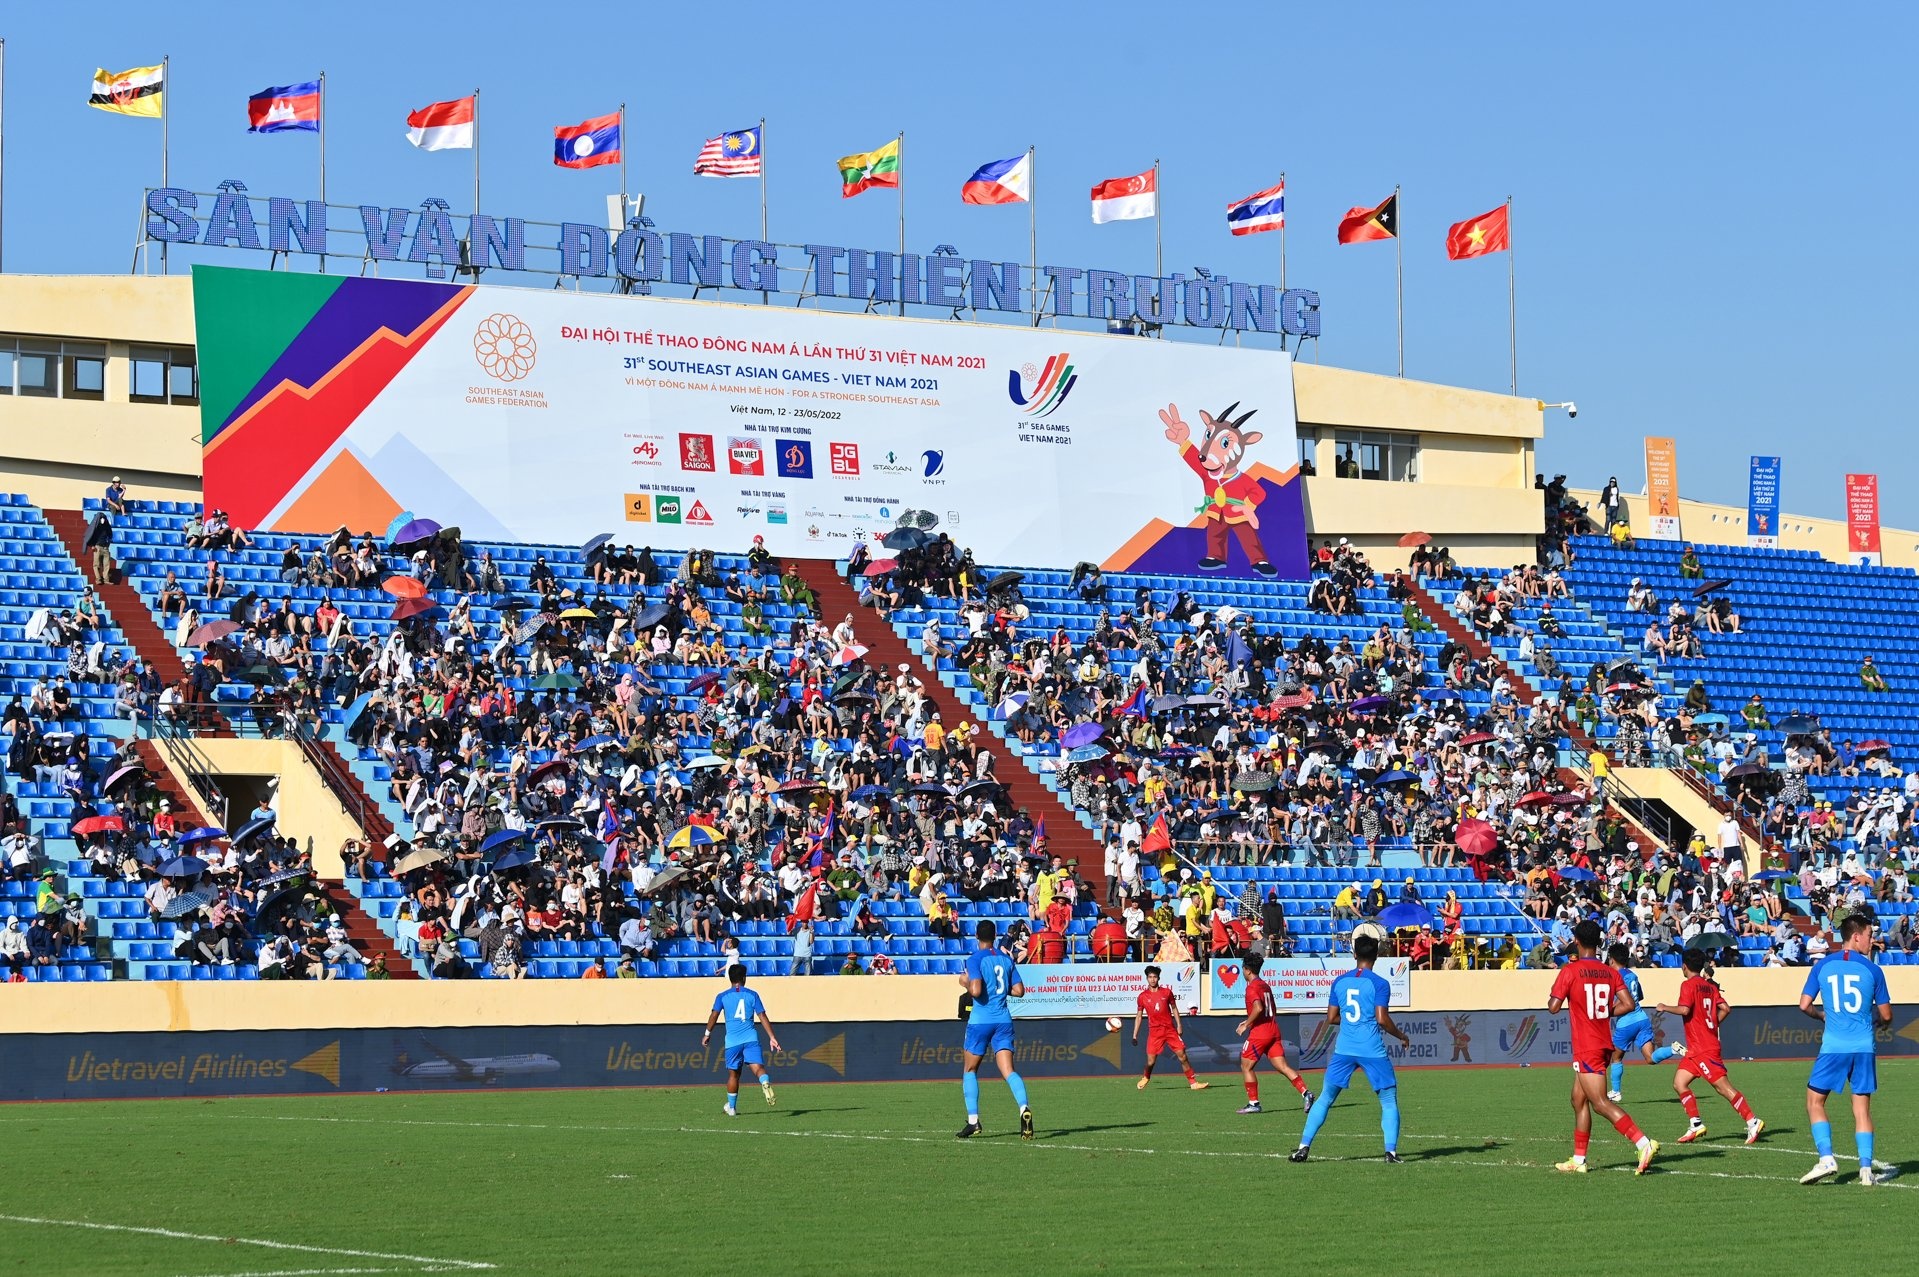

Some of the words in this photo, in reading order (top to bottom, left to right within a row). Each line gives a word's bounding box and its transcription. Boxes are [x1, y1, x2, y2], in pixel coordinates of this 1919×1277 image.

[146, 179, 327, 254] SÂN
[359, 197, 525, 279] VẬN
[557, 216, 779, 295] ĐỘNG
[804, 244, 1020, 312] THIÊN
[1044, 265, 1321, 337] TRƯỜNG
[561, 326, 588, 342] ĐẠI
[592, 327, 620, 344] HỘI
[624, 329, 653, 345] THỂ
[657, 334, 699, 348] THAO
[702, 336, 747, 352] ĐÔNG
[751, 341, 785, 355] NAM
[789, 342, 800, 356] Á
[804, 343, 832, 358] LẦN
[836, 346, 866, 361] THỨ
[869, 350, 882, 362] 31
[886, 350, 917, 366] VIỆT
[921, 355, 953, 367] NAM
[957, 356, 986, 369] 2021
[624, 356, 645, 369] 31st
[649, 359, 731, 376] SOUTHEAST
[735, 365, 778, 379] ASIAN
[782, 369, 830, 383] GAMES
[842, 373, 871, 386] VIET
[875, 376, 907, 388] NAM
[910, 378, 938, 390] 2021
[465, 396, 496, 405] GAMES
[497, 398, 548, 408] FEDERATION
[468, 387, 518, 397] SOUTHEAST
[520, 390, 544, 399] ASIAN
[625, 376, 634, 386] VÌ
[636, 378, 656, 389] MỘT
[658, 379, 686, 389] ĐÔNG
[688, 382, 708, 391] NAM
[710, 381, 717, 392] Á
[719, 385, 746, 395] MẠNH
[749, 385, 762, 395] MẼ
[764, 386, 784, 396] HƠN
[792, 389, 809, 398] FOR
[811, 391, 818, 399] A
[820, 392, 866, 402] STRONGER
[868, 394, 918, 405] SOUTHEAST
[920, 398, 940, 407] ASIA
[730, 404, 748, 414] Việt
[750, 406, 775, 416] Nam,
[777, 408, 786, 416] 12
[793, 409, 842, 420] 23/05/2022
[1018, 434, 1034, 442] VIET
[1036, 435, 1054, 443] NAM
[1055, 436, 1072, 445] 2021
[1030, 423, 1045, 431] SEA
[1046, 424, 1071, 432] GAMES
[684, 461, 711, 469] SAIGON
[734, 450, 744, 458] BIA
[872, 464, 912, 472] STAVIAN
[994, 964, 1005, 995] 3
[1046, 975, 1059, 984] HỘI
[1296, 969, 1309, 977] HAI
[1263, 991, 1274, 1017] 11
[1345, 988, 1361, 1023] 5
[1583, 983, 1610, 1020] 18
[1827, 974, 1863, 1014] 15
[734, 998, 746, 1023] 4
[1154, 1002, 1160, 1012] 4
[1703, 997, 1714, 1029] 3
[1549, 1017, 1568, 1032] 31st
[1754, 1020, 1823, 1045] Vietrave
[606, 1041, 709, 1071] Vietravel
[1409, 1043, 1438, 1058] 2021
[67, 1050, 186, 1082] Vietravel
[187, 1053, 288, 1084] Airlines
